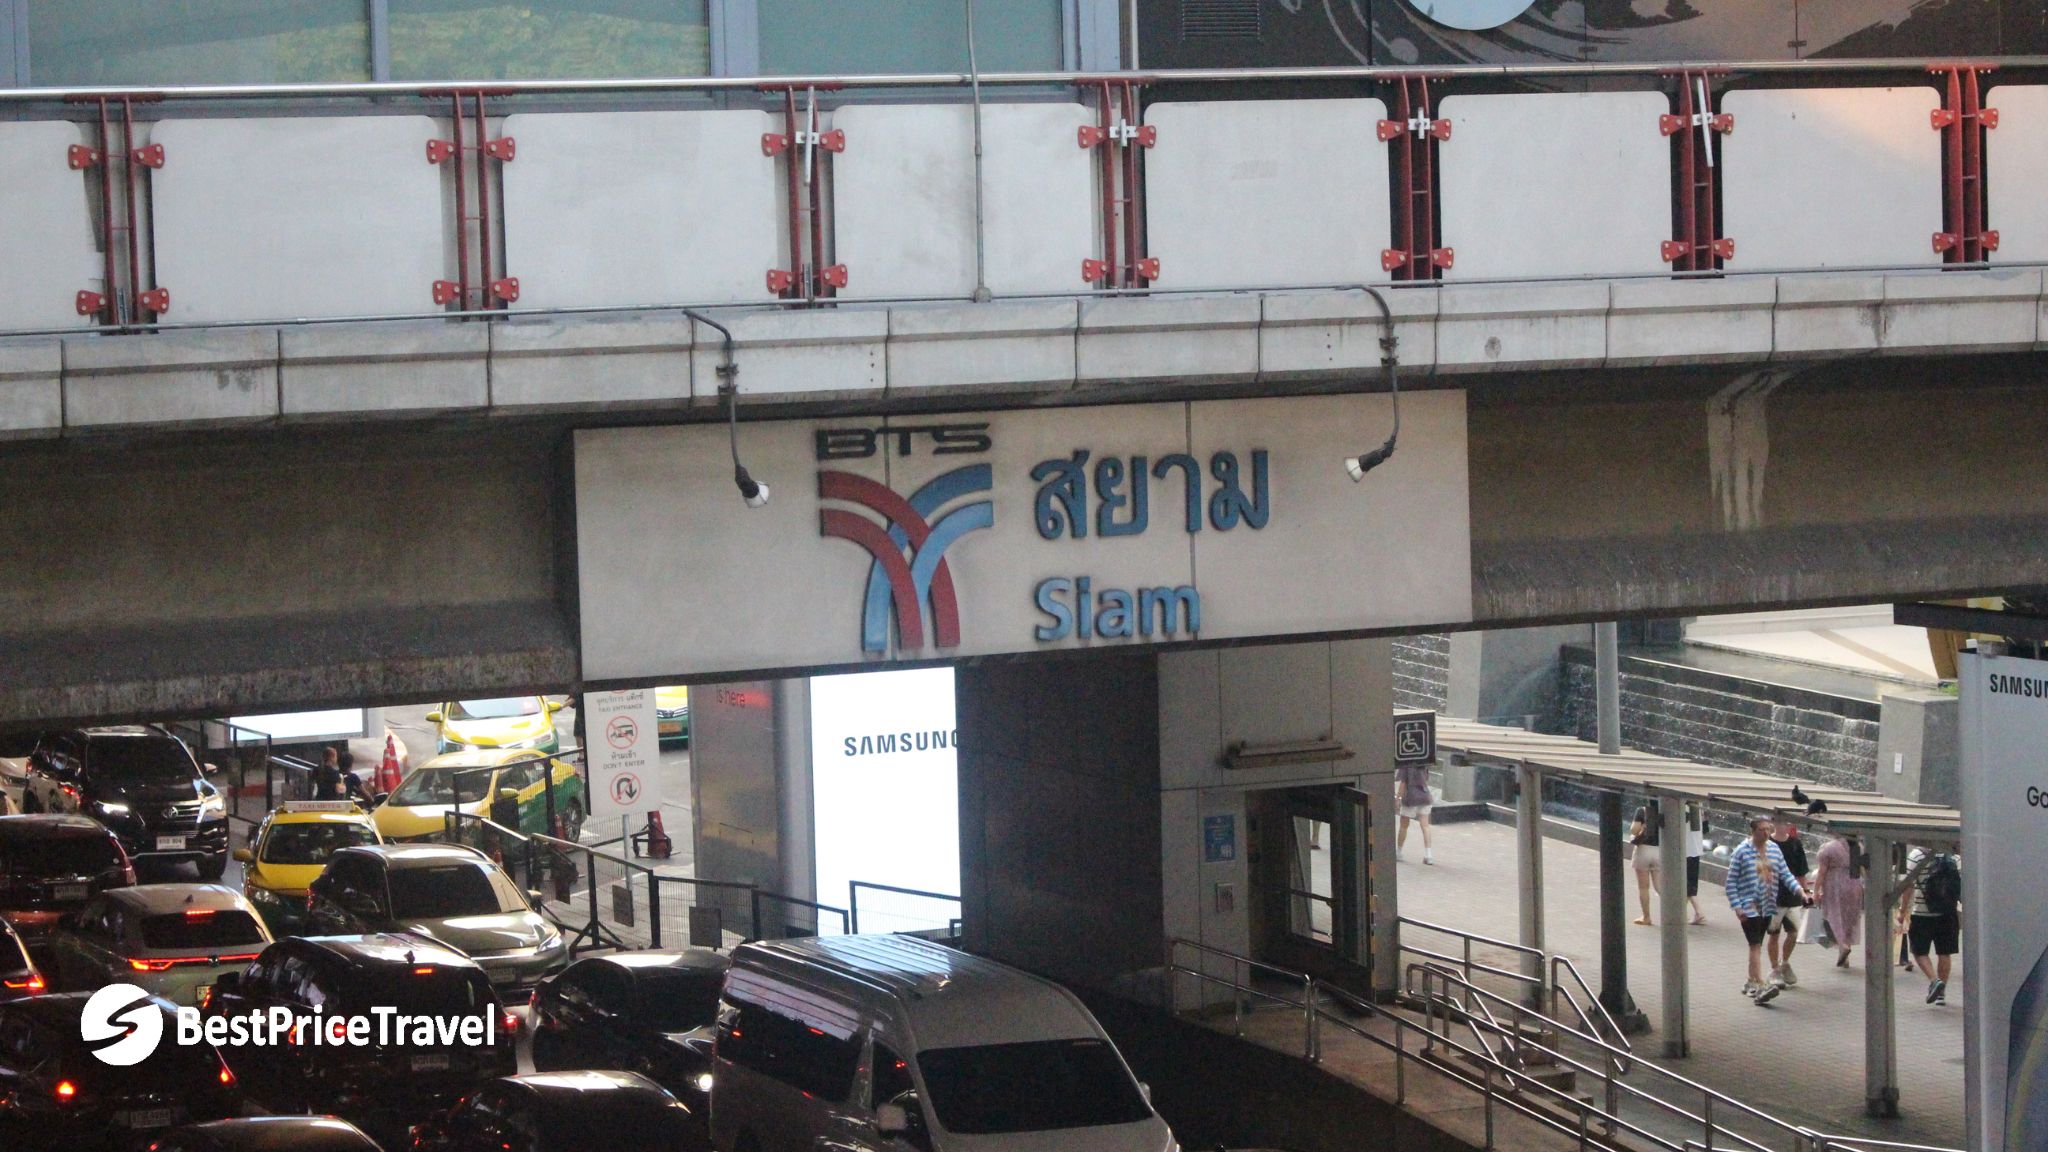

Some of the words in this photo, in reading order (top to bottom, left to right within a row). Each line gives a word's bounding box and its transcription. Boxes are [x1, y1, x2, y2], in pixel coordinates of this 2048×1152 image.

[816, 423, 992, 460] BTS
[1030, 449, 1269, 540] สยาม
[1035, 575, 1201, 641] Siam
[613, 703, 643, 712] ENTRANCE
[724, 687, 746, 708] here
[625, 759, 645, 768] ENTER
